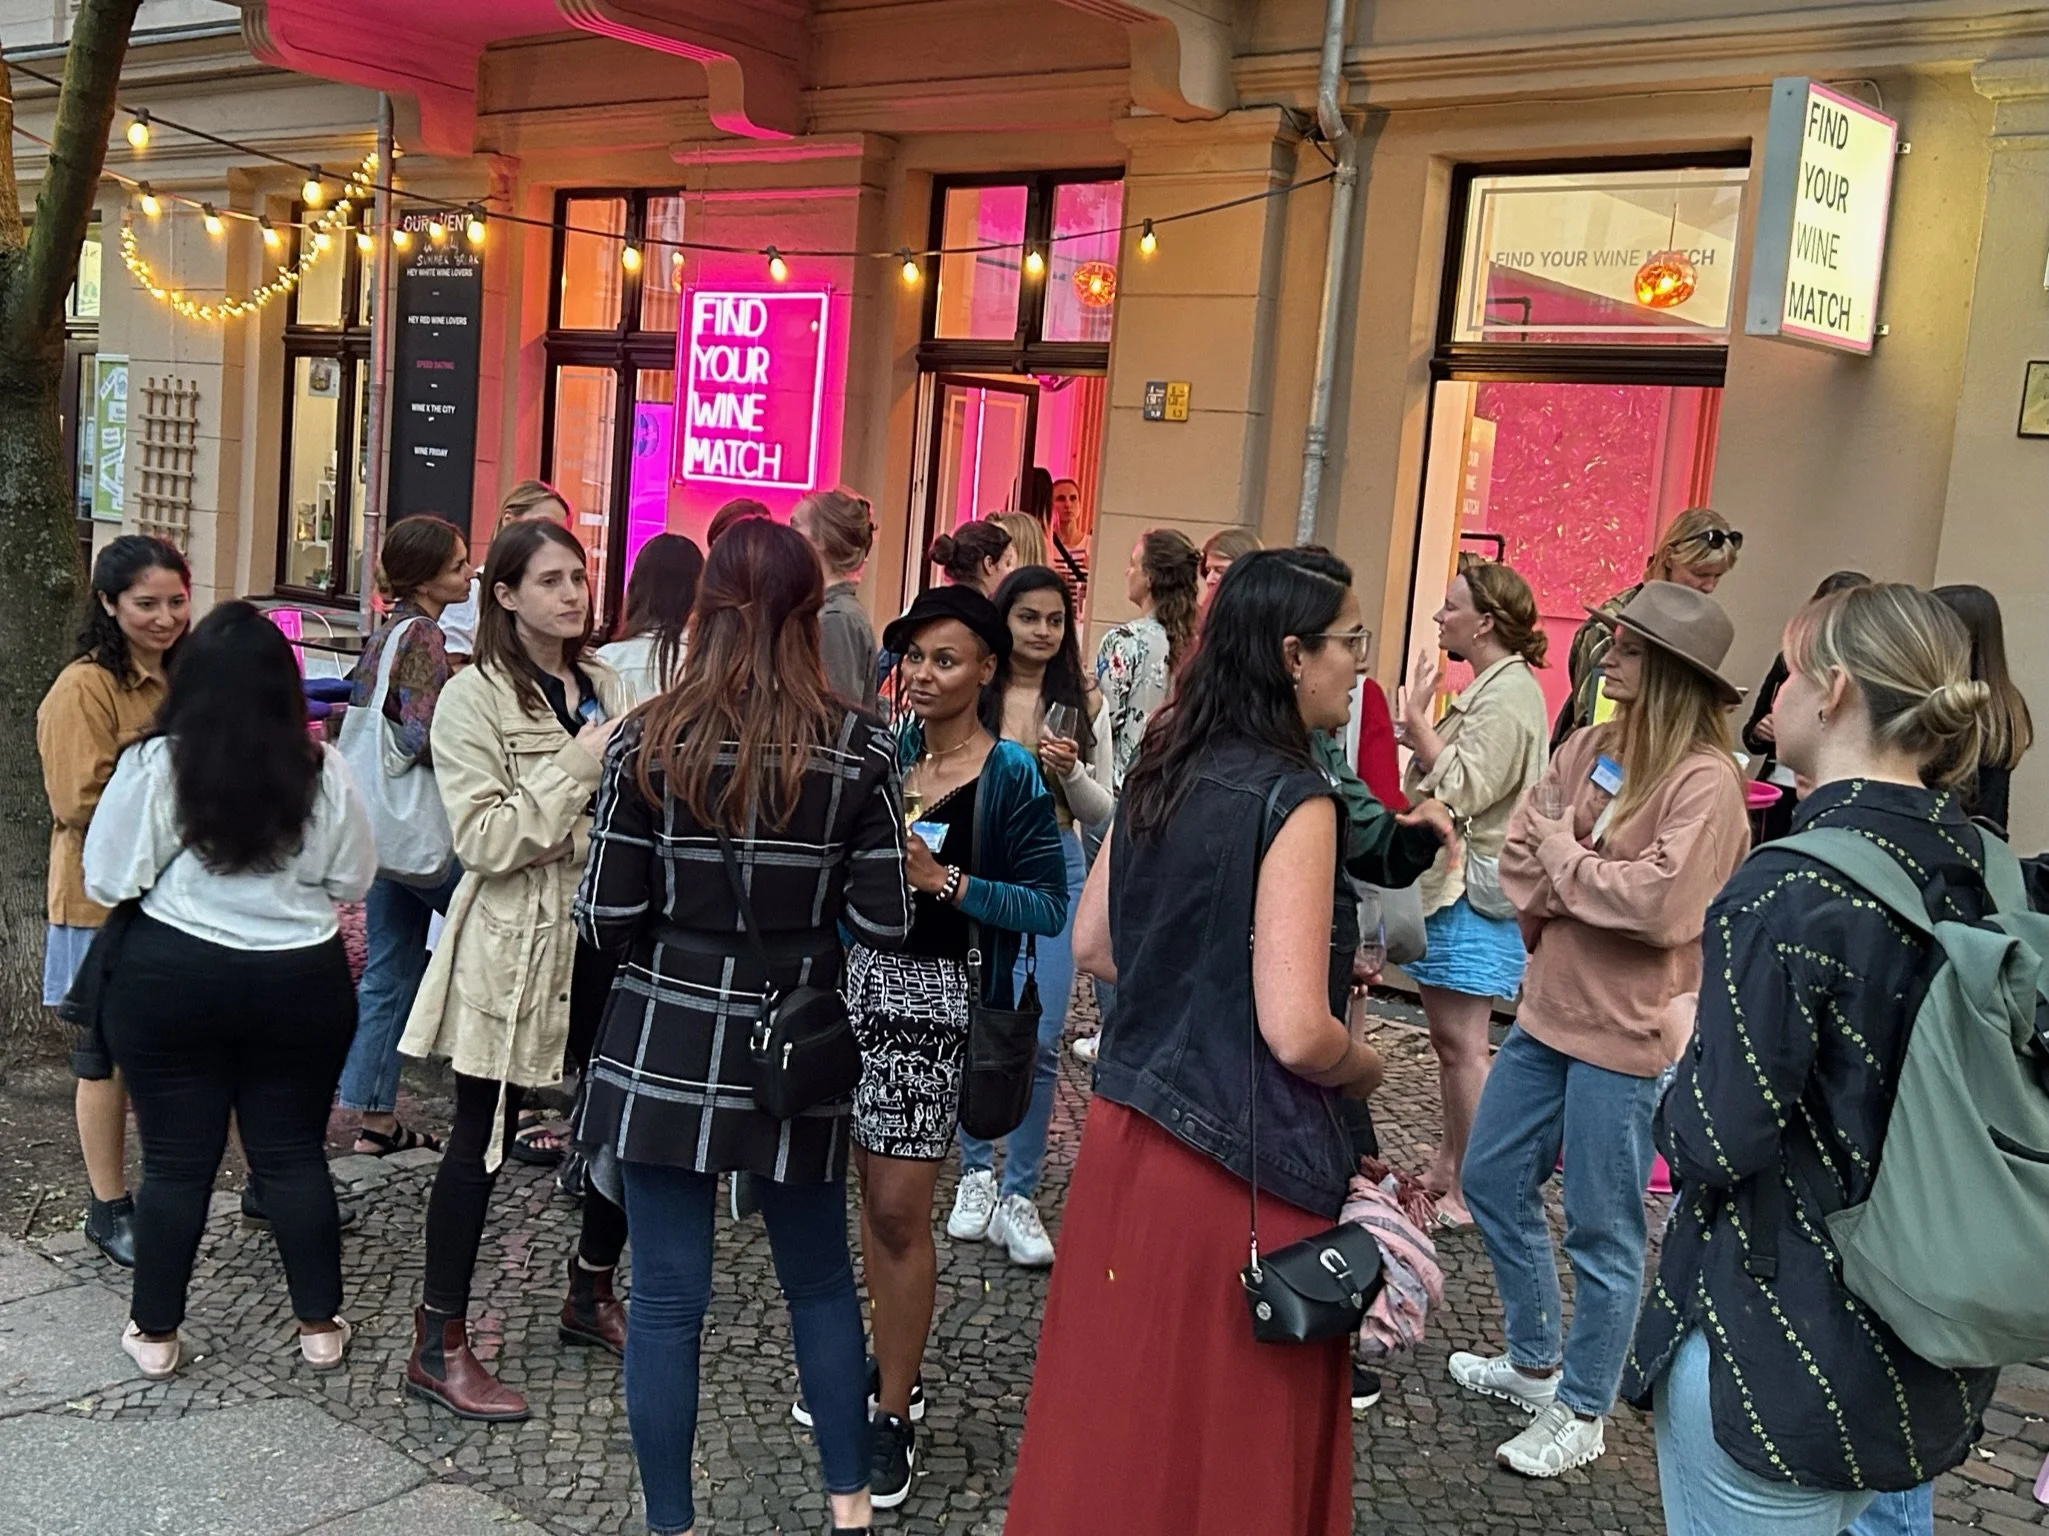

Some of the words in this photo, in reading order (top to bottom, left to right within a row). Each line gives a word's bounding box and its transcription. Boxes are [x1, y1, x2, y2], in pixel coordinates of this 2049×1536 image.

[1807, 101, 1849, 150] FIND
[1805, 161, 1849, 213] YOUR
[404, 214, 430, 232] OUR
[1495, 251, 1535, 267] FIND
[1541, 251, 1588, 267] YOUR
[1594, 250, 1641, 267] WINE
[1796, 222, 1840, 270] WINE
[406, 267, 418, 277] HEY
[419, 267, 435, 277] WHITE
[437, 267, 450, 277] WINE
[451, 267, 473, 277] LOVERS
[408, 315, 419, 324] HEY
[420, 315, 431, 324] RED
[431, 315, 445, 325] WINE
[446, 316, 467, 326] LOVERS
[696, 298, 768, 338] FIND
[1788, 281, 1851, 332] MATCH
[695, 345, 770, 385] YOUR
[411, 402, 425, 412] WINE
[431, 404, 441, 413] THE
[442, 405, 456, 415] CITY
[692, 391, 766, 432] WINE
[414, 446, 428, 456] WINE
[429, 448, 448, 457] FRIDAY
[688, 437, 782, 480] MATCH
